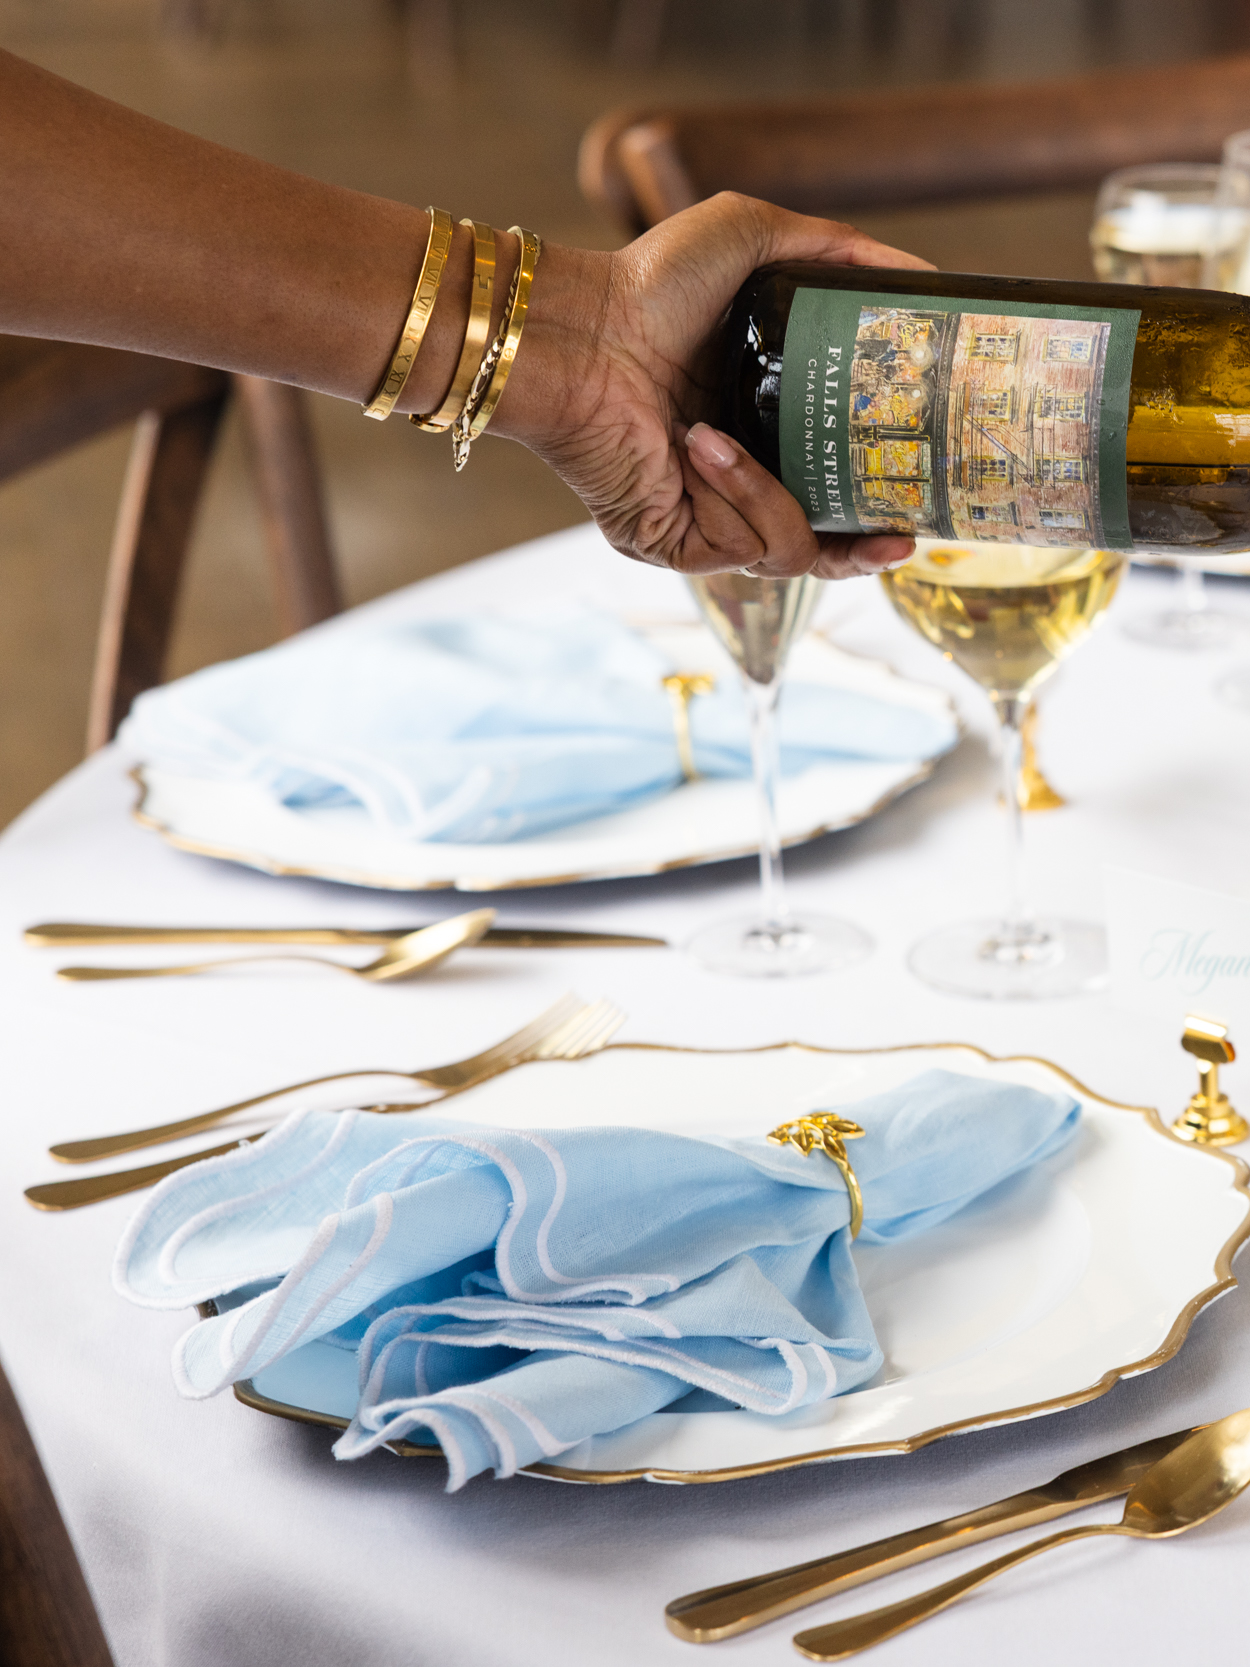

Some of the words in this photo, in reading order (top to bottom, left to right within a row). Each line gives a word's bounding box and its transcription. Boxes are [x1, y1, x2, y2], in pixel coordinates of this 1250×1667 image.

[805, 358, 818, 471] CHARDONNAY
[822, 345, 843, 429] FALLS
[808, 486, 820, 513] 2023
[823, 440, 846, 521] STREET
